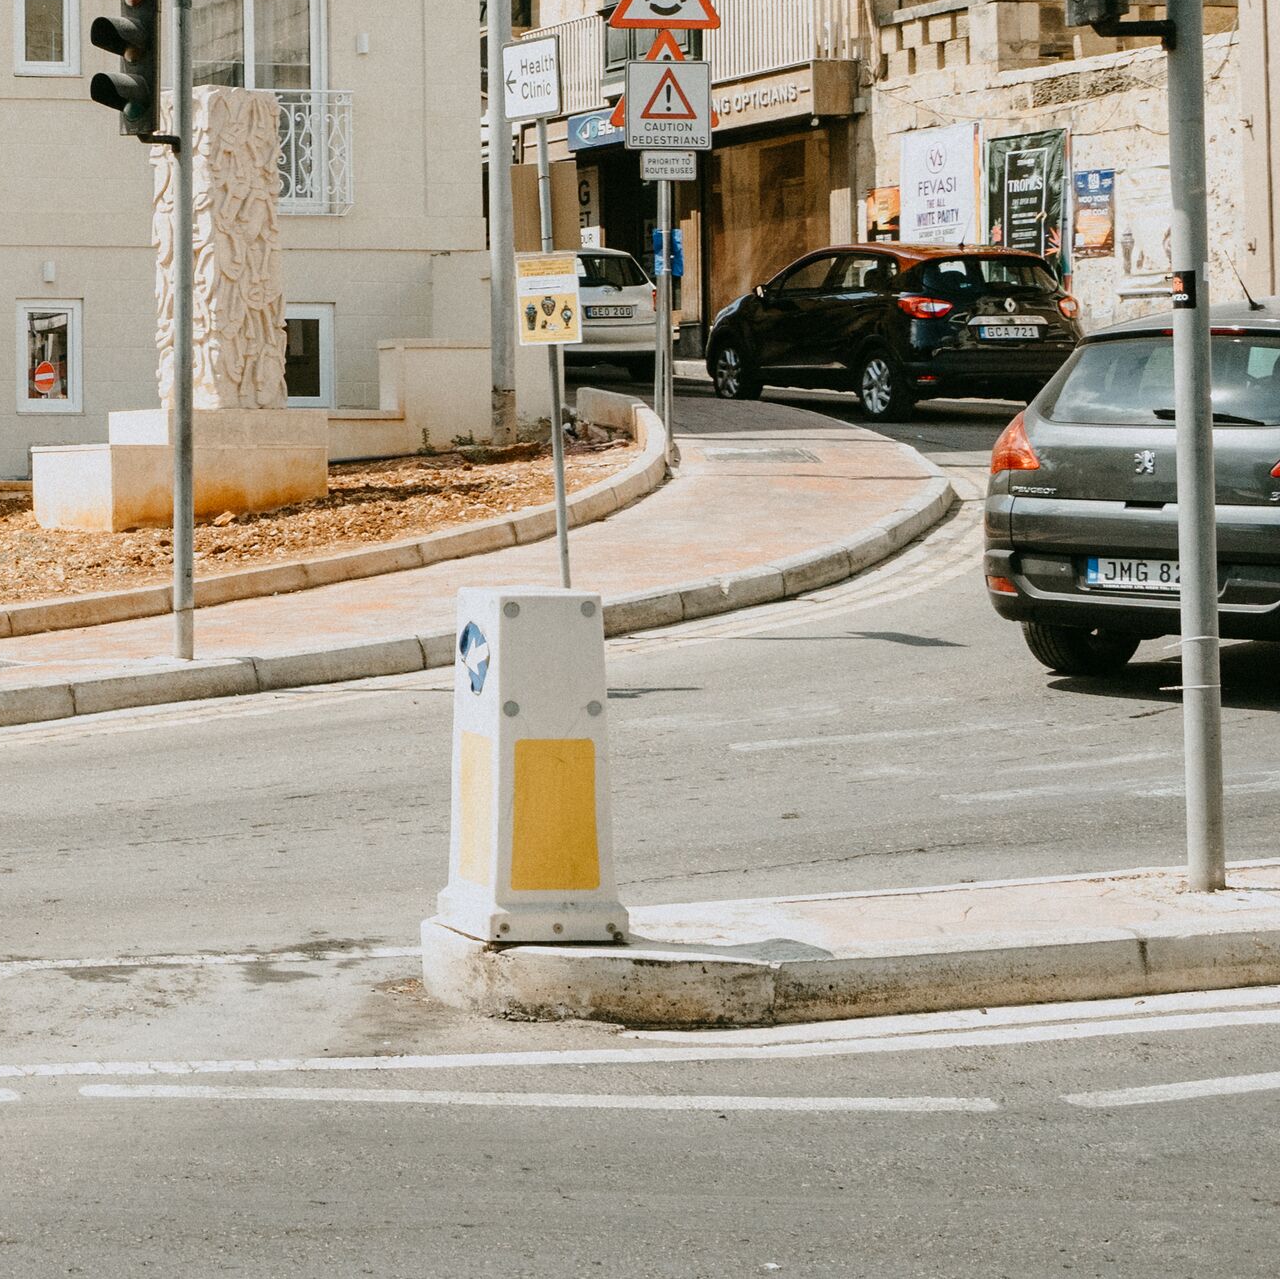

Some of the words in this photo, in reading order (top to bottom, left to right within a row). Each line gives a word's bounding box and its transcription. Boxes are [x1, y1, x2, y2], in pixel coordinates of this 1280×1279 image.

[520, 54, 555, 76] Health
[521, 80, 552, 99] Clinic
[733, 82, 798, 113] OPTICIANS
[644, 122, 693, 132] CAUTION
[632, 135, 706, 145] PEDESTRIANS
[647, 158, 680, 166] PRIORITY
[681, 157, 691, 165] TO
[670, 166, 694, 174] BUSES
[918, 177, 957, 197] FEVASI
[937, 208, 960, 225] PARTY
[987, 327, 1011, 337] GCA
[1013, 327, 1035, 337] 721
[1011, 485, 1057, 495] PEUGEOT
[1104, 561, 1148, 583] JMG
